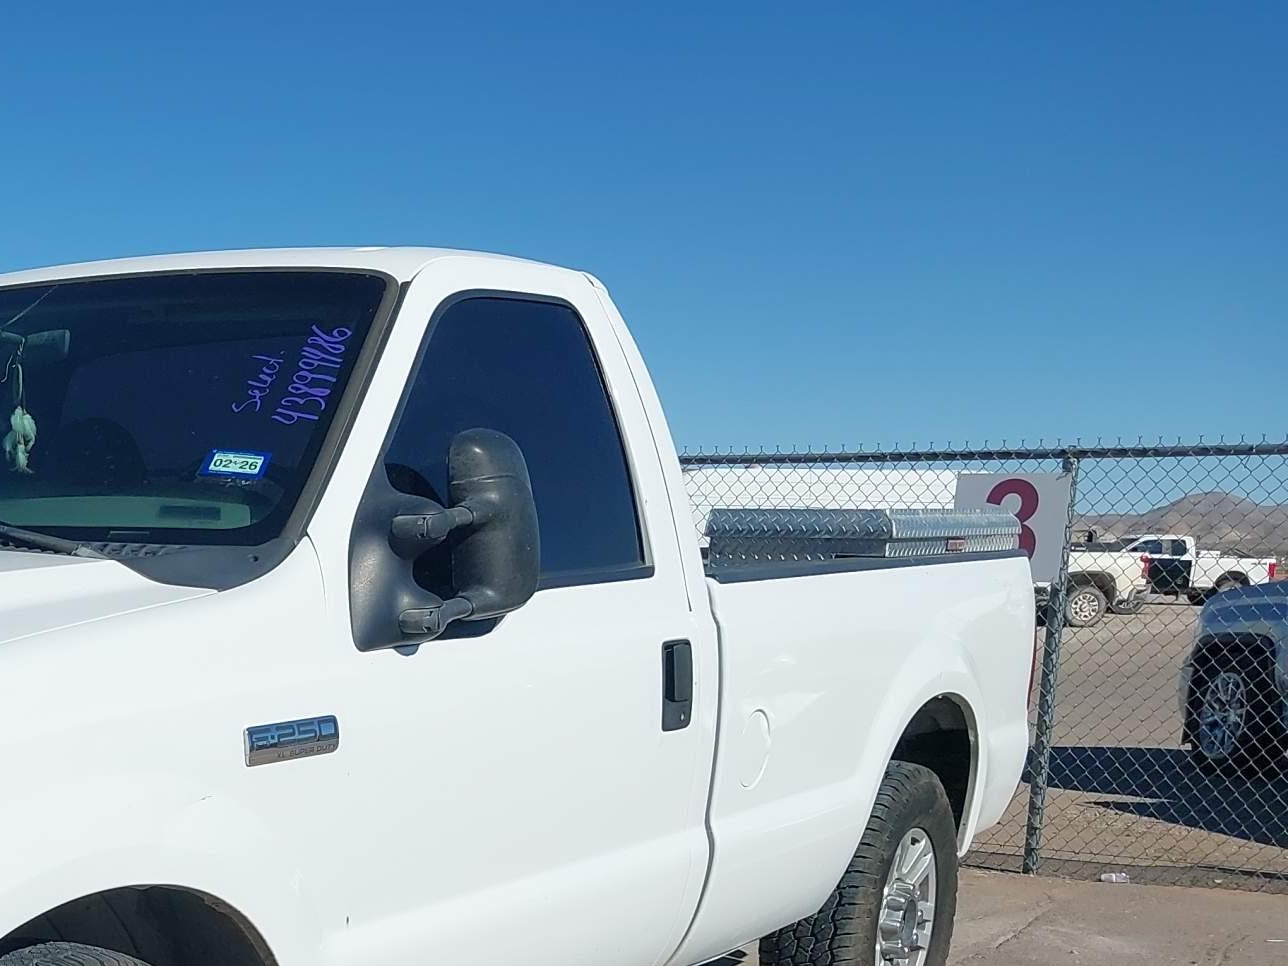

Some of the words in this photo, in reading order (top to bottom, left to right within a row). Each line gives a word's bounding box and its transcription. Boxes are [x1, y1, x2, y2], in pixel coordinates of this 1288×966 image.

[272, 325, 352, 424] 43899486
[986, 478, 1039, 560] 3
[249, 717, 337, 751] F-250
[316, 743, 337, 753] DUTY
